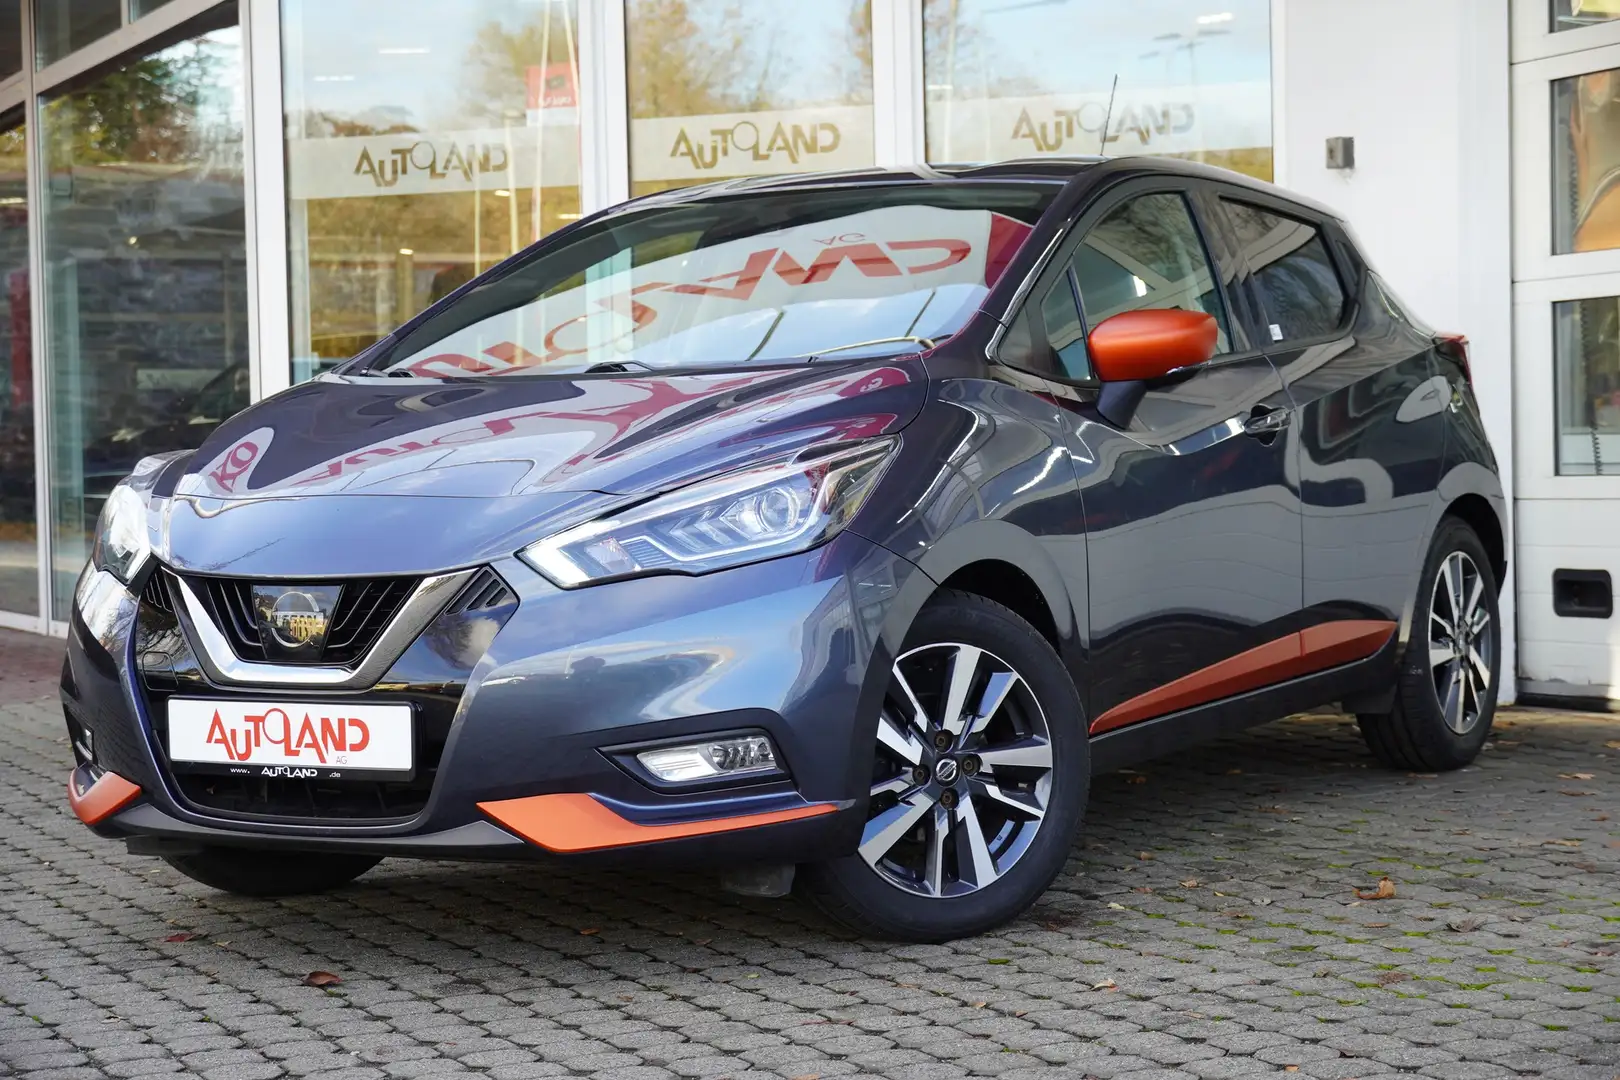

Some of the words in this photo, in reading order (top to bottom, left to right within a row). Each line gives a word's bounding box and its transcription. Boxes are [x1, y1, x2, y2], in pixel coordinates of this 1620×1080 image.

[670, 121, 841, 169] AUTOLAND
[1011, 102, 1195, 151] AUTOLAND
[354, 141, 508, 187] AUTOLAND
[206, 708, 370, 764] AUTOLAND
[261, 766, 318, 778] AUTOLAND
[335, 755, 348, 765] AG
